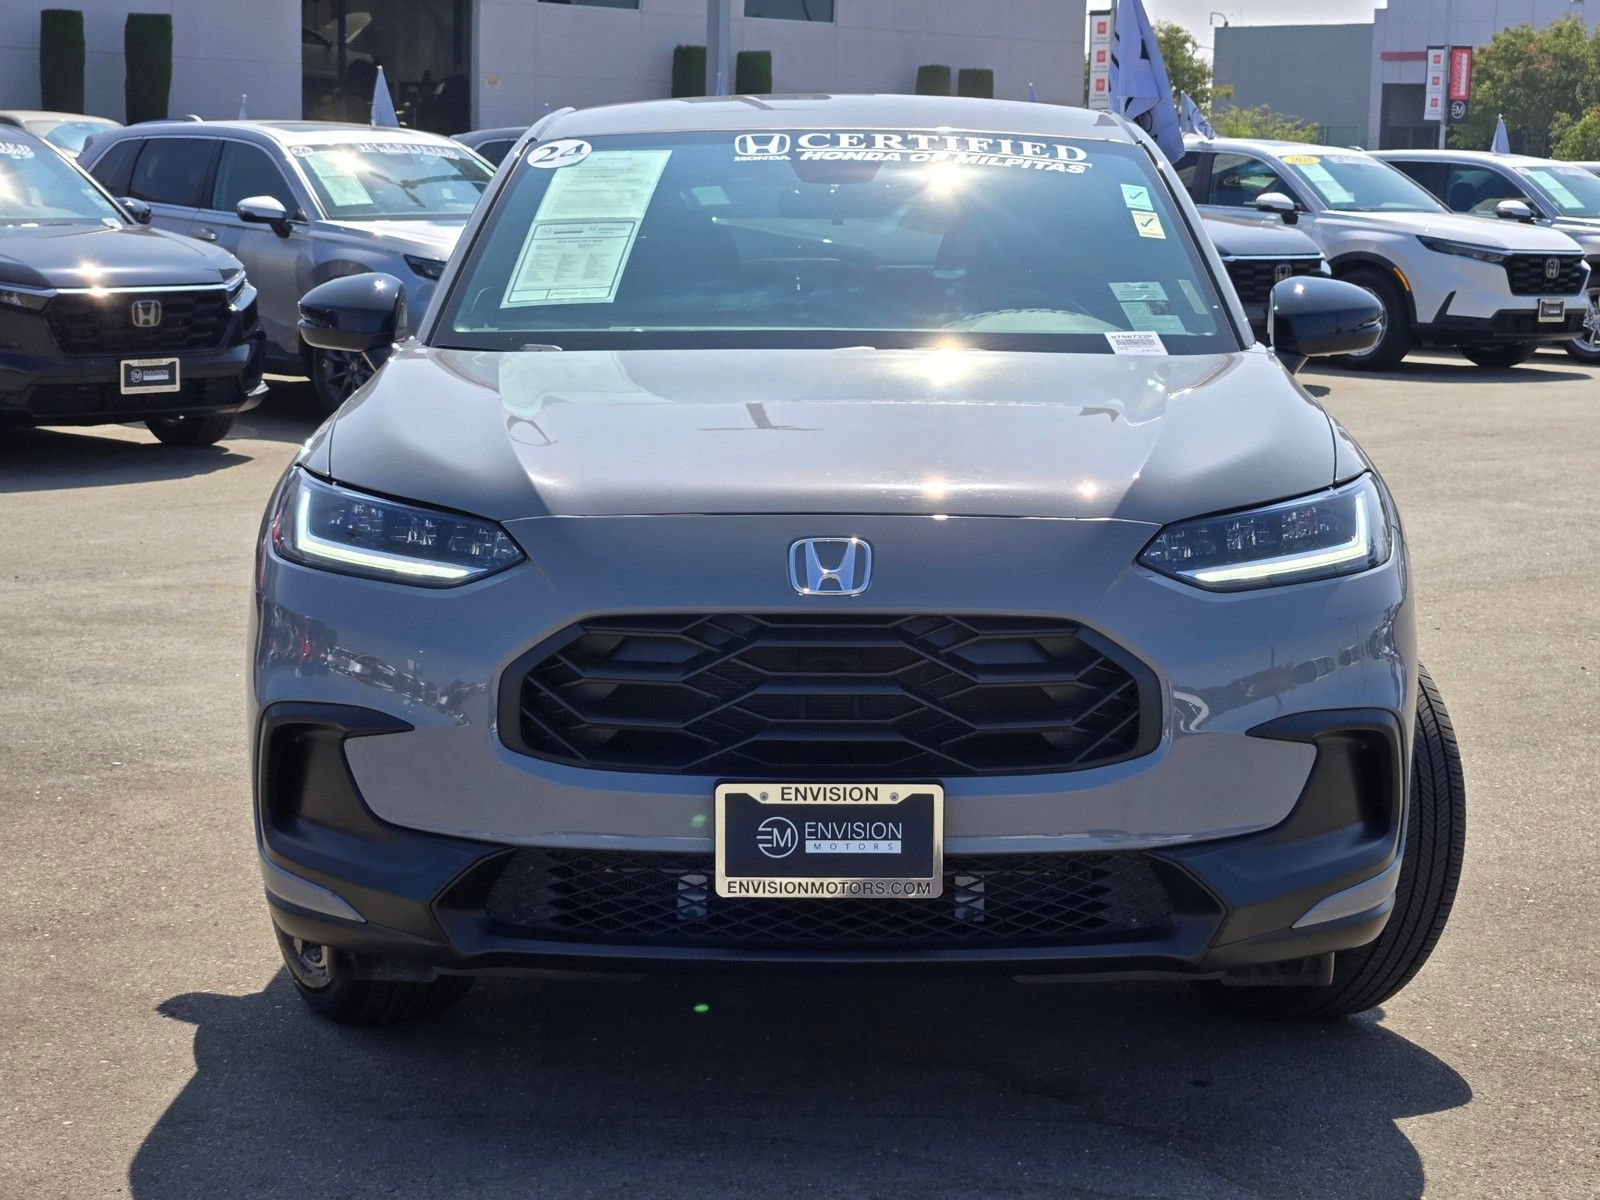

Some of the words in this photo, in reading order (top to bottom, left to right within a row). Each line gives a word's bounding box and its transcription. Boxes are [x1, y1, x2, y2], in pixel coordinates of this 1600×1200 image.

[532, 144, 584, 163] 24
[798, 132, 1087, 162] CERTIFIED
[734, 154, 791, 162] HONDA
[800, 150, 901, 162] HONDA
[909, 152, 947, 163] OF
[950, 152, 1087, 174] MILPITAS
[780, 786, 879, 802] ENVISION
[805, 822, 902, 839] ENVISION
[813, 842, 893, 851] MOTORS
[727, 881, 931, 894] ENVISIONMOTORS.COM
